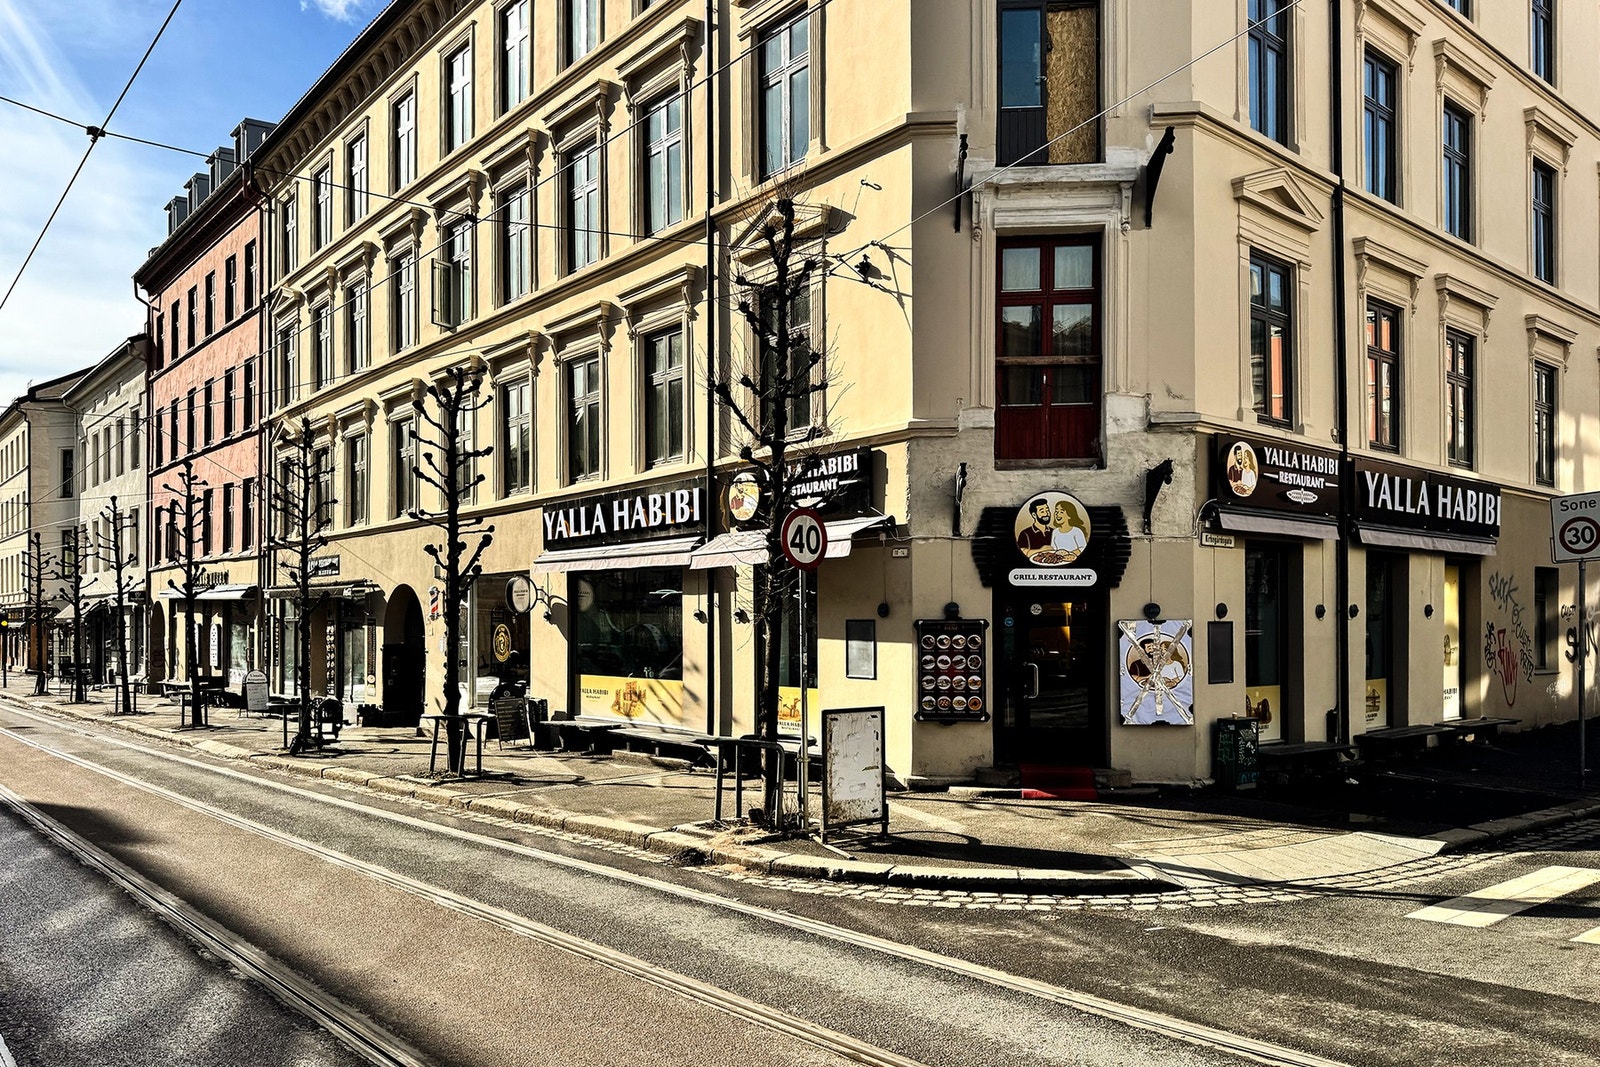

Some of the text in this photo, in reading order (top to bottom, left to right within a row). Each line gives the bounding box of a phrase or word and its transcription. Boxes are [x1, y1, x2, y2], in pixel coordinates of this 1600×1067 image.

[1263, 446, 1339, 476] YALLA HABIBI
[790, 478, 838, 496] STAURANT
[1278, 470, 1325, 489] RESTAURANT
[1364, 470, 1502, 527] YALLA HABIBI
[1559, 499, 1597, 512] Sone
[543, 487, 700, 541] YALLA HABIBI
[789, 524, 821, 555] 40
[1566, 525, 1595, 546] 30
[1013, 573, 1037, 581] GRILL
[581, 687, 592, 695] ALLA
